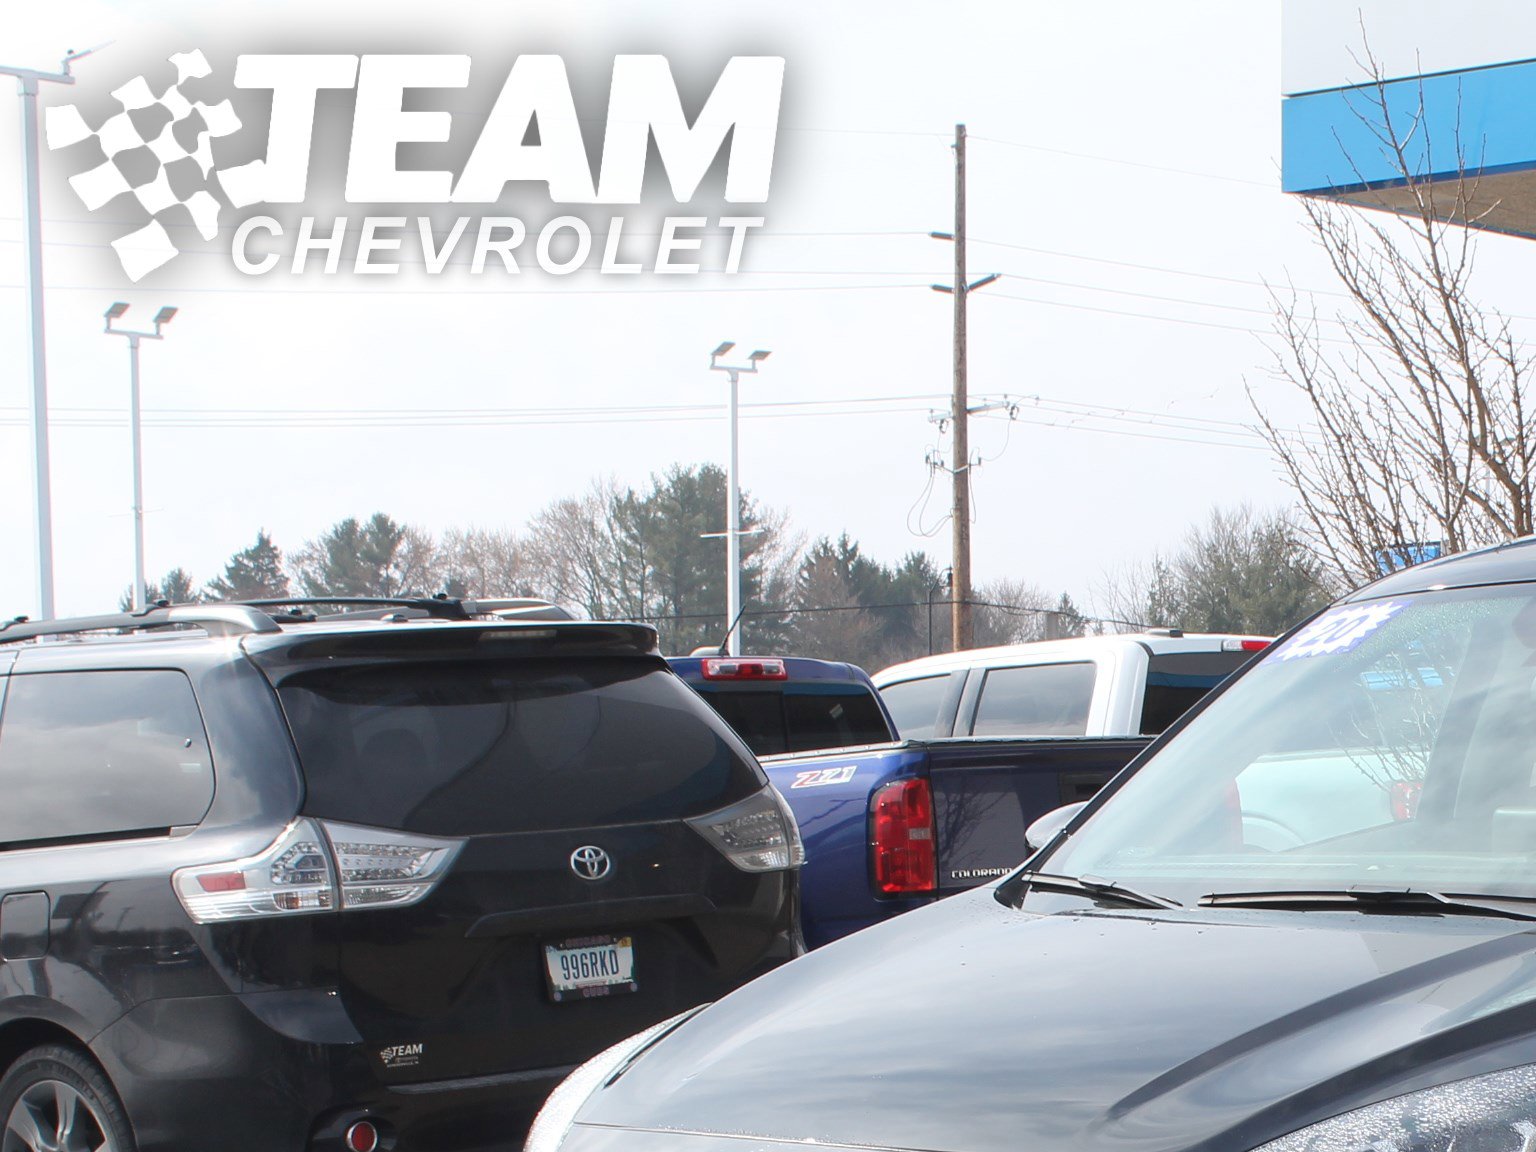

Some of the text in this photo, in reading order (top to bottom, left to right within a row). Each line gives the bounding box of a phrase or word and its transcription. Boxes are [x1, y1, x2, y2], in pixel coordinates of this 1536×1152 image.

[790, 765, 857, 788] Z71
[561, 950, 619, 980] 996RKD
[392, 1043, 423, 1056] TEAM
